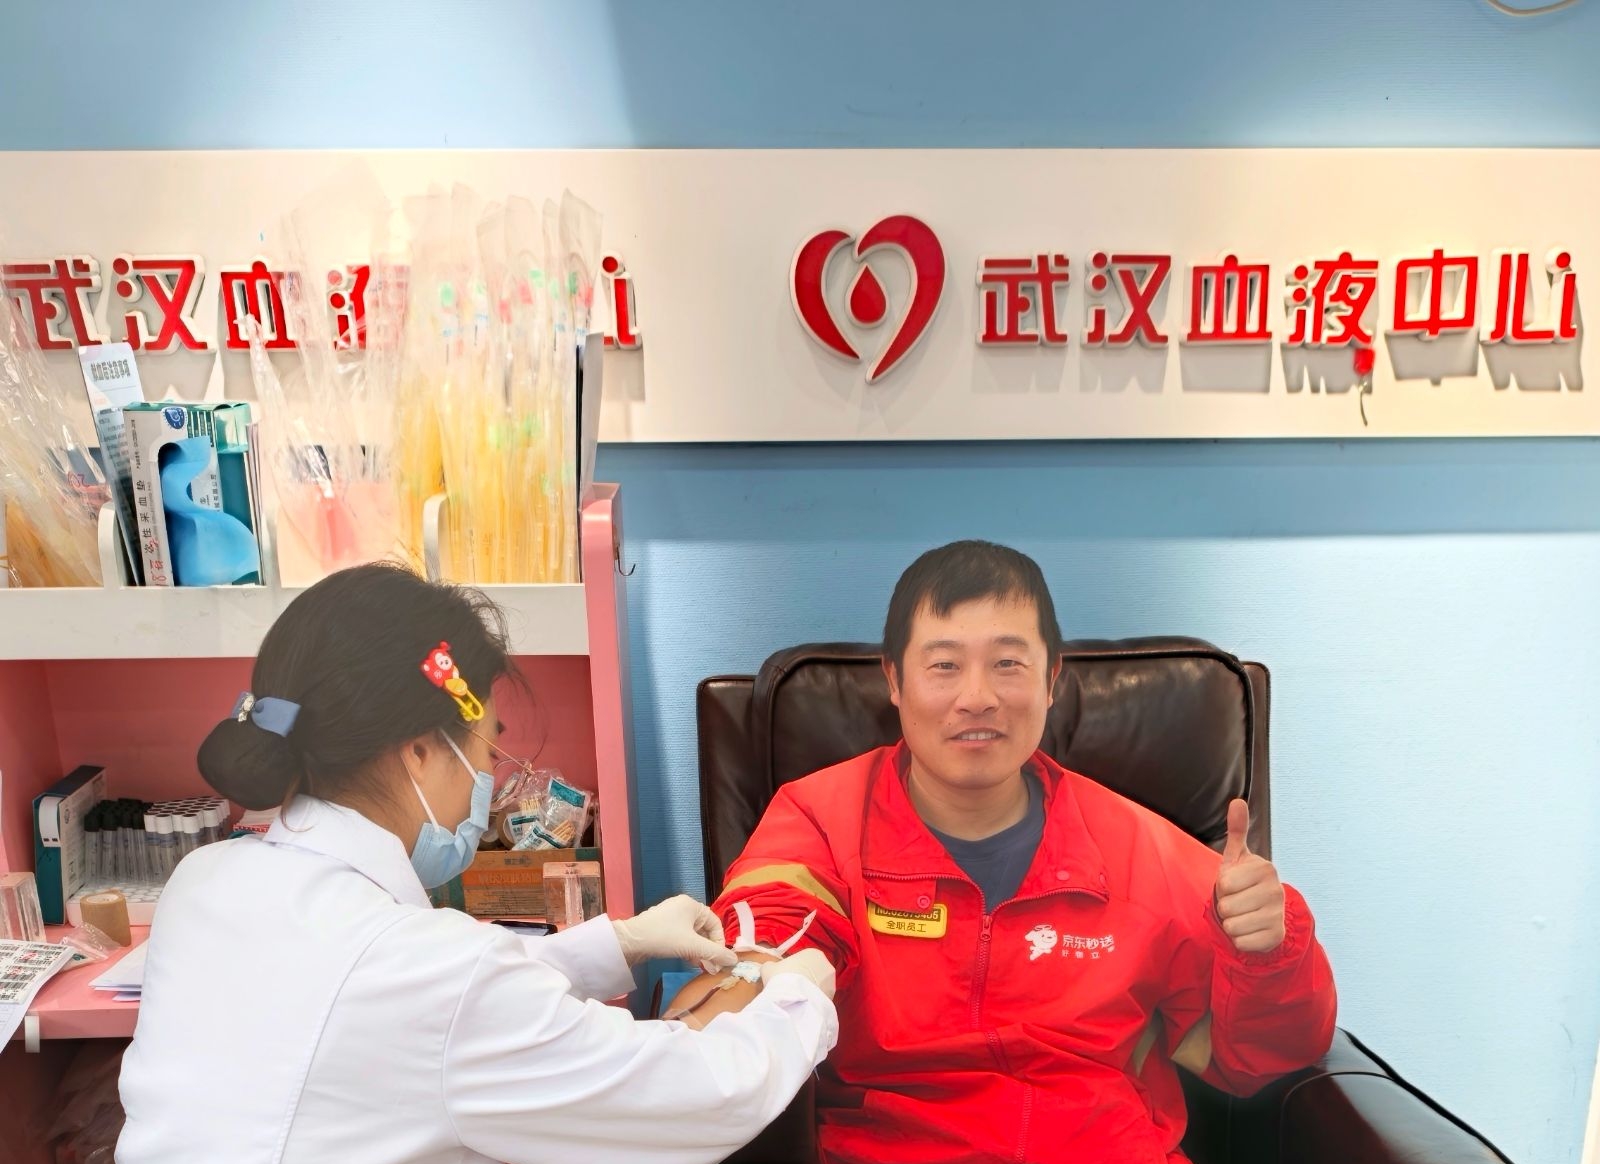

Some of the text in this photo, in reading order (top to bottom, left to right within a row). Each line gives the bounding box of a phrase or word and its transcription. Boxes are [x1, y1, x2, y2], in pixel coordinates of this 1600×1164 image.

[978, 249, 1578, 346] 武汉血液中心
[886, 920, 927, 933] 全职员工
[1062, 934, 1114, 950] 京东秒送
